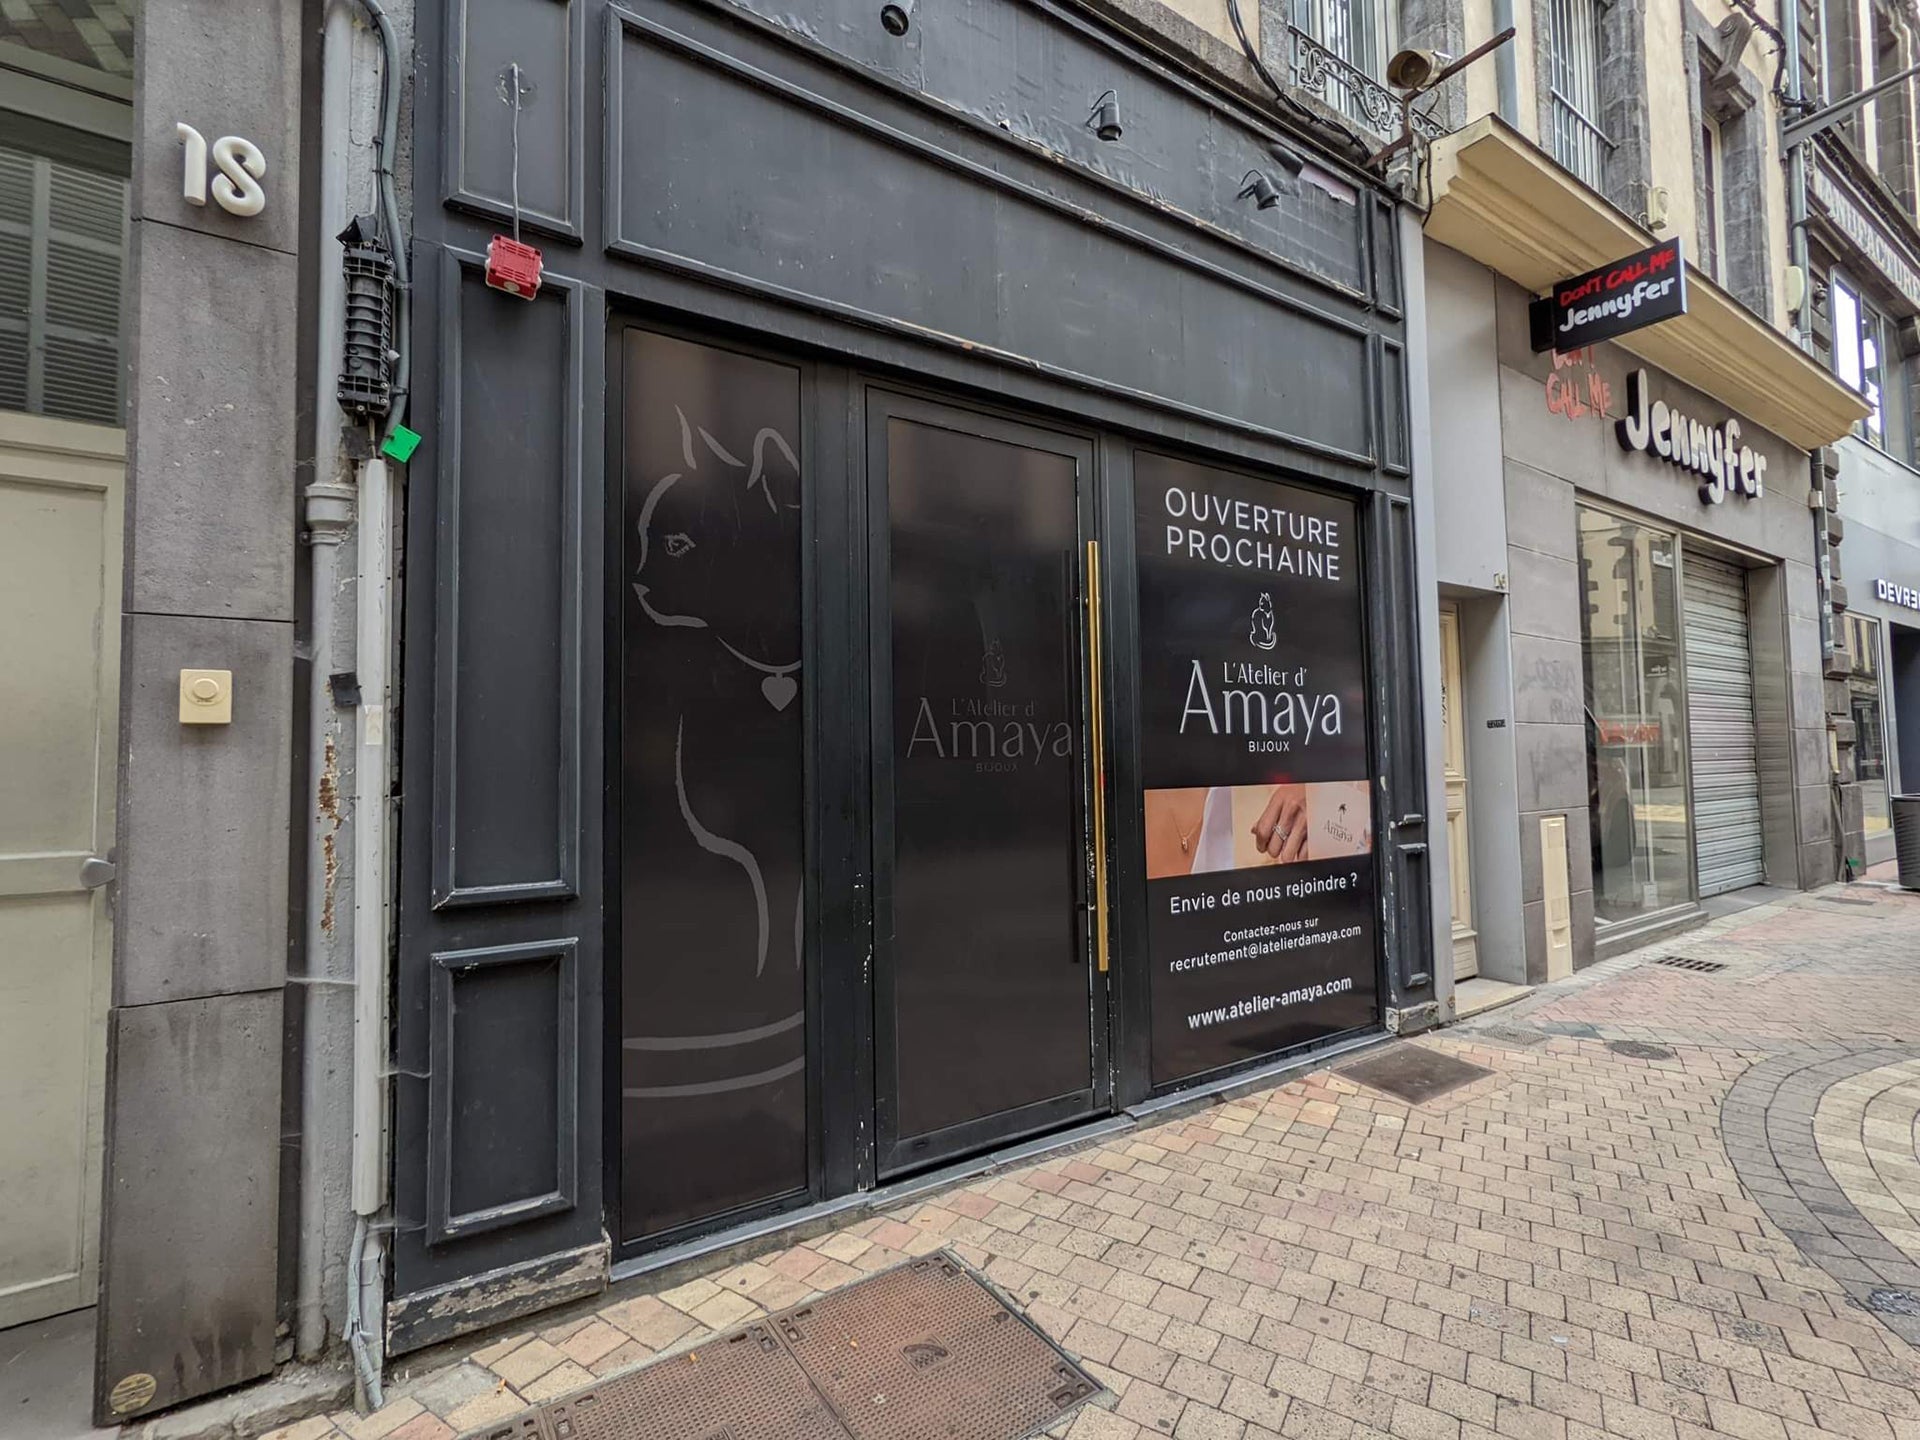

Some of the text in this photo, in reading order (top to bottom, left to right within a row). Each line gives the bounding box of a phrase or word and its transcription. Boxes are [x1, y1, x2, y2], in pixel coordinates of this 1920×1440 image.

[1606, 261, 1649, 290] CALL
[1649, 248, 1675, 275] ME
[1559, 277, 1675, 332] Jennyfer
[1621, 367, 1767, 504] Jennyfer
[1165, 487, 1339, 548] OUVERTURE
[1166, 525, 1340, 581] PROCHAINE
[1878, 578, 1920, 610] DEVRE
[1223, 661, 1307, 686] L'Atelier d'
[1179, 659, 1341, 746] Amaya
[906, 697, 1073, 766] Amaya
[1248, 740, 1290, 752] BIJOUX
[1170, 872, 1358, 914] Envie de nous rejoindre ?
[1170, 924, 1361, 972] recrutement@latelierdamaya.com
[1223, 916, 1319, 943] Contactez-nous sur
[1188, 976, 1352, 1029] www.atelier-amaya.com
